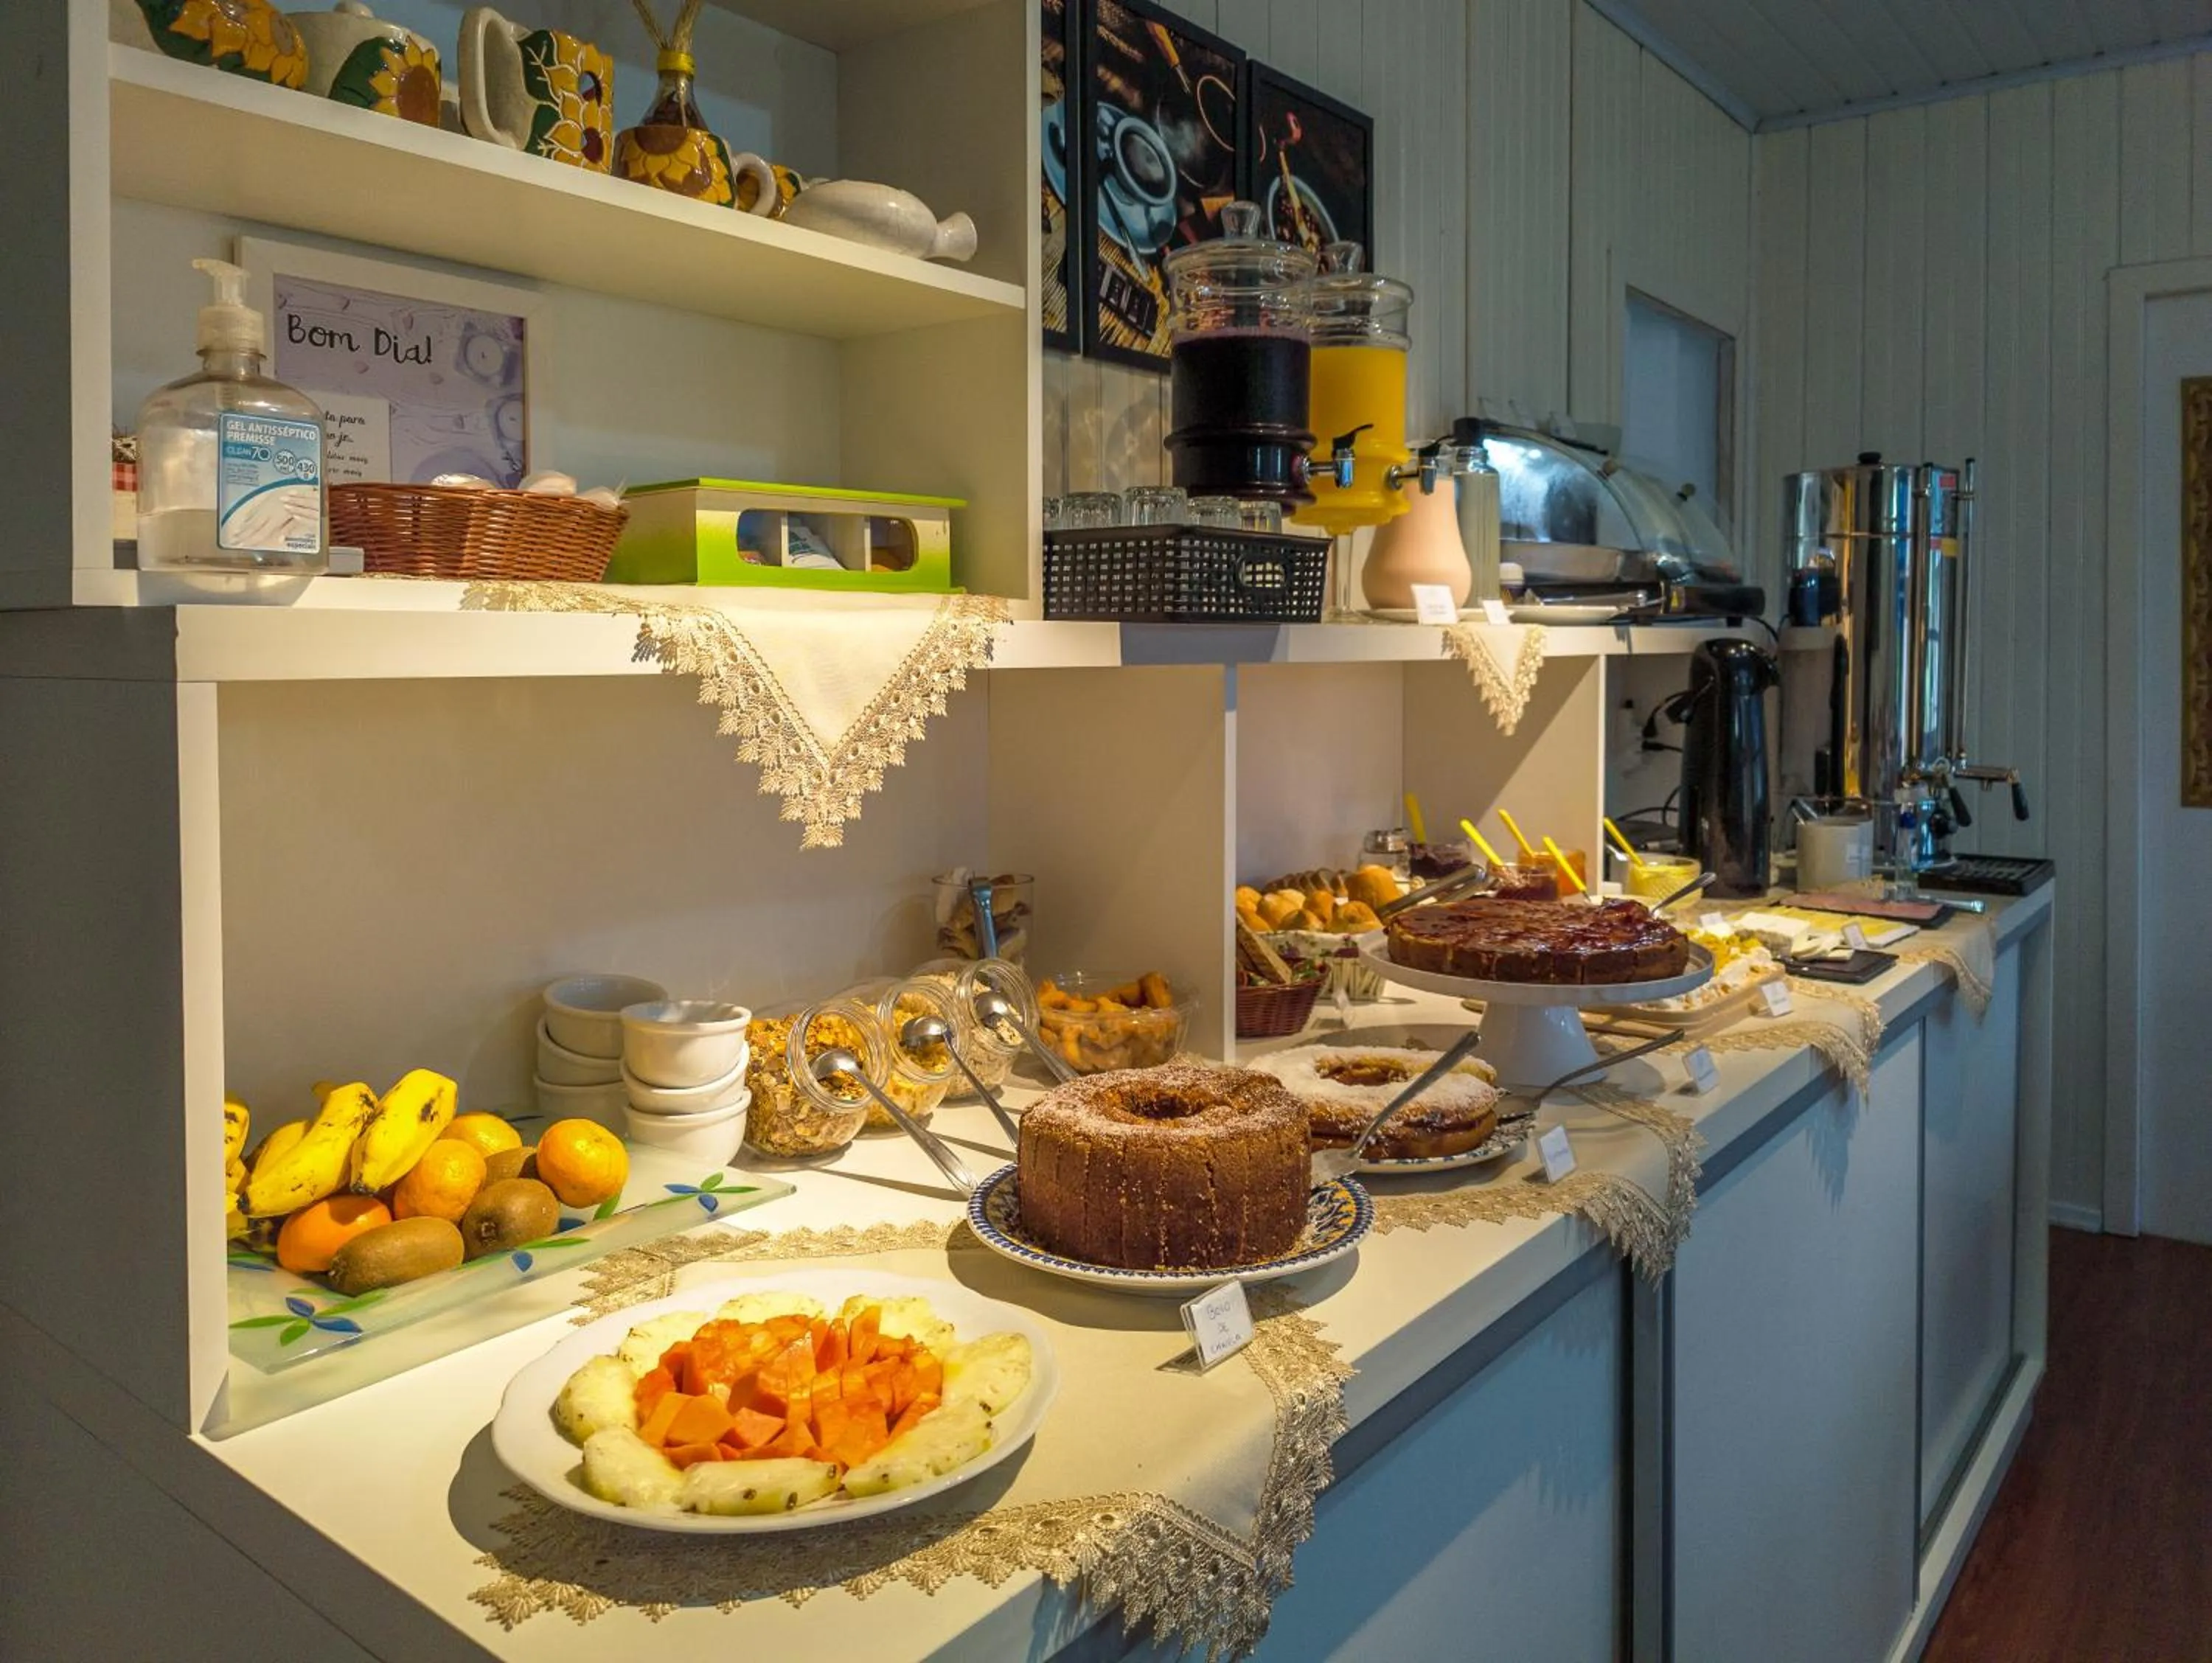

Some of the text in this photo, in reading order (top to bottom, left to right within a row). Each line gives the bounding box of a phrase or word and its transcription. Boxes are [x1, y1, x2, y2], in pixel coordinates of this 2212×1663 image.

[288, 313, 432, 364] Bom Dia!
[226, 420, 246, 431] GEL
[248, 422, 316, 440] ANTISSÉPTICO
[226, 430, 276, 445] PREMISSE
[251, 446, 271, 461] 70
[276, 455, 294, 465] 500
